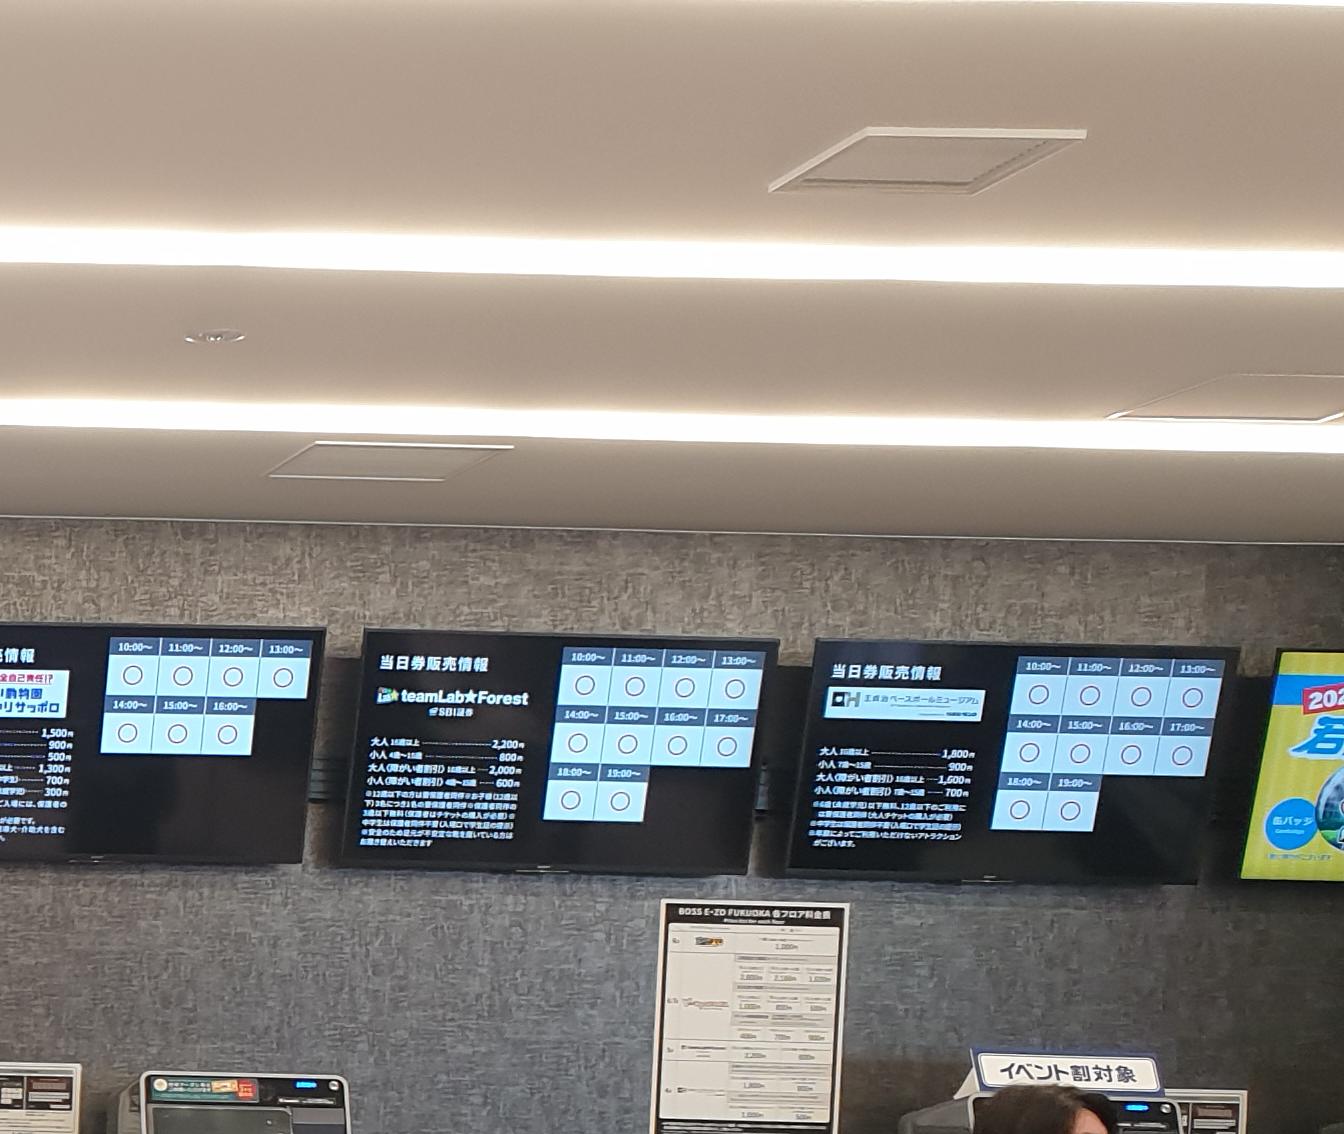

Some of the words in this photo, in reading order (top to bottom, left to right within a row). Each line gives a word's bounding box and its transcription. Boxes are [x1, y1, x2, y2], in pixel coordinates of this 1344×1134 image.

[380, 656, 488, 672] 当日券販売情報
[831, 664, 942, 681] 当日券販売情報
[1000, 1063, 1137, 1082] イベント割対象
